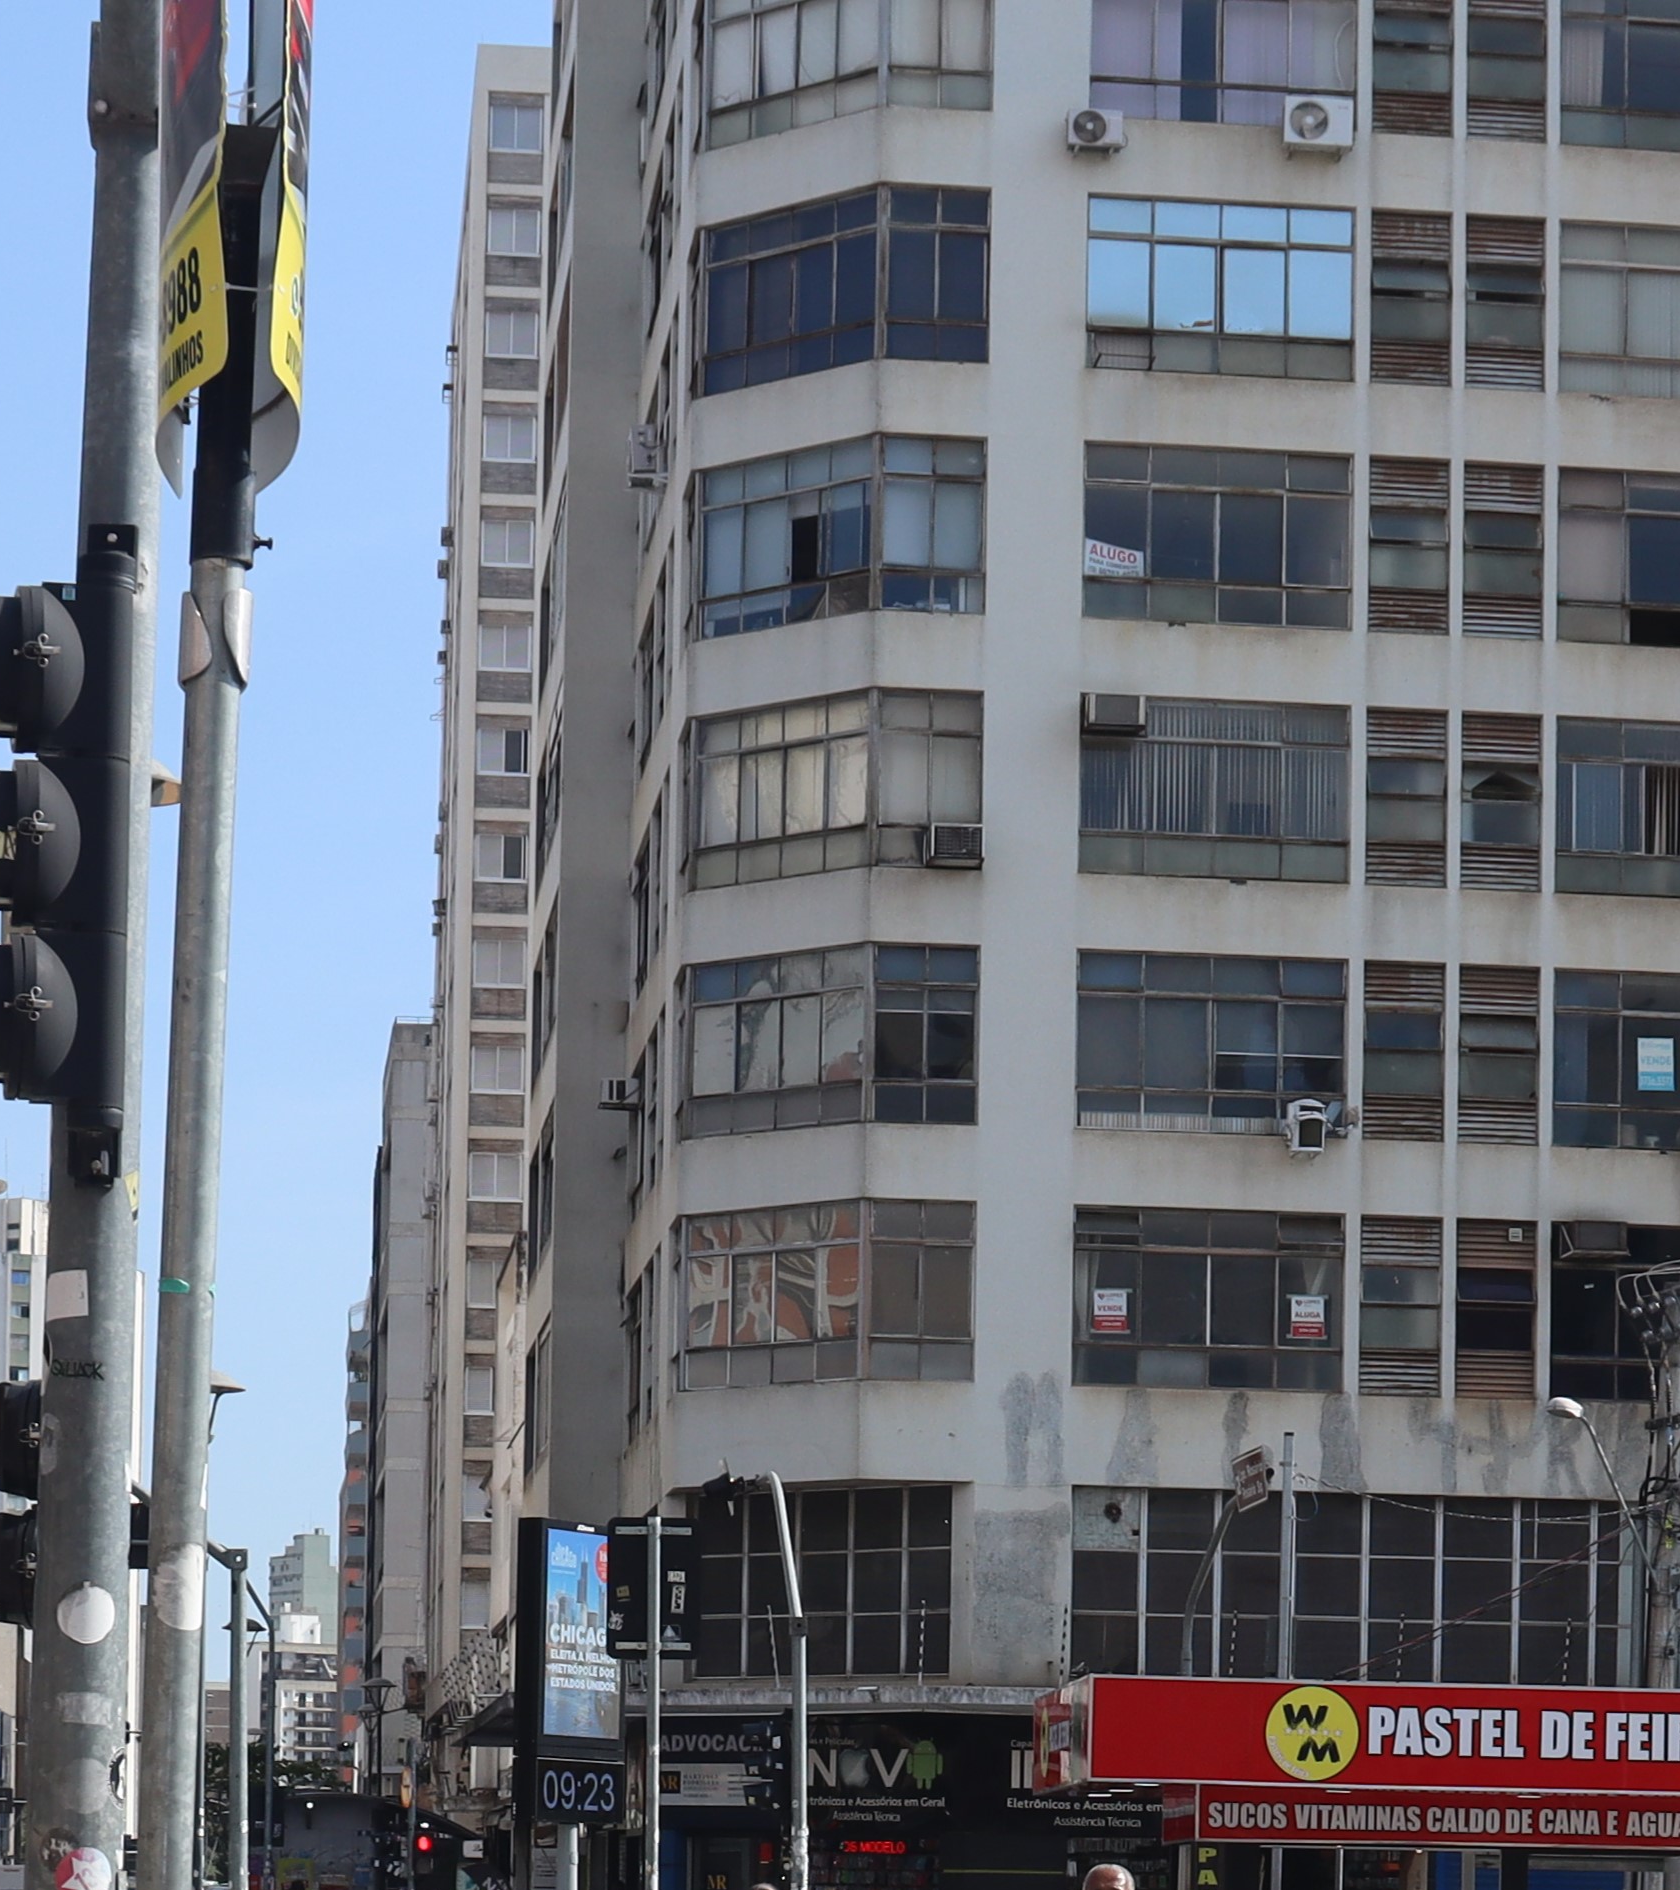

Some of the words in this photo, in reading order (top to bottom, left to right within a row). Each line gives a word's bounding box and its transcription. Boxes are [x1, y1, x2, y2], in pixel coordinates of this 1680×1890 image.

[1089, 543, 1138, 565] ALUGO
[1096, 1304, 1124, 1313] VENDE
[1294, 1310, 1321, 1319] ALUGA
[549, 1623, 608, 1648] CHICAG
[550, 1676, 585, 1690] ESTADOS
[586, 1679, 616, 1693] UNIDOS
[1367, 1706, 1525, 1758] PASTEL
[1540, 1709, 1595, 1760] DE
[1010, 1739, 1034, 1749] Capa
[543, 1770, 616, 1812] 09:23
[808, 1796, 846, 1807] trônicos
[920, 1797, 946, 1808] Geral
[1007, 1797, 1072, 1811] Eletrônicos
[1073, 1801, 1081, 1810] e
[1082, 1800, 1144, 1812] Acessórios
[874, 1811, 901, 1823] Técnica
[1053, 1815, 1106, 1828] Assistência
[1107, 1816, 1142, 1828] Técnica
[1208, 1801, 1289, 1830] SUCOS
[1293, 1803, 1422, 1833] VITAMINAS
[1425, 1806, 1501, 1835] CALDO
[1505, 1807, 1533, 1835] DE
[1538, 1808, 1601, 1836] CANA
[1606, 1810, 1619, 1836] E
